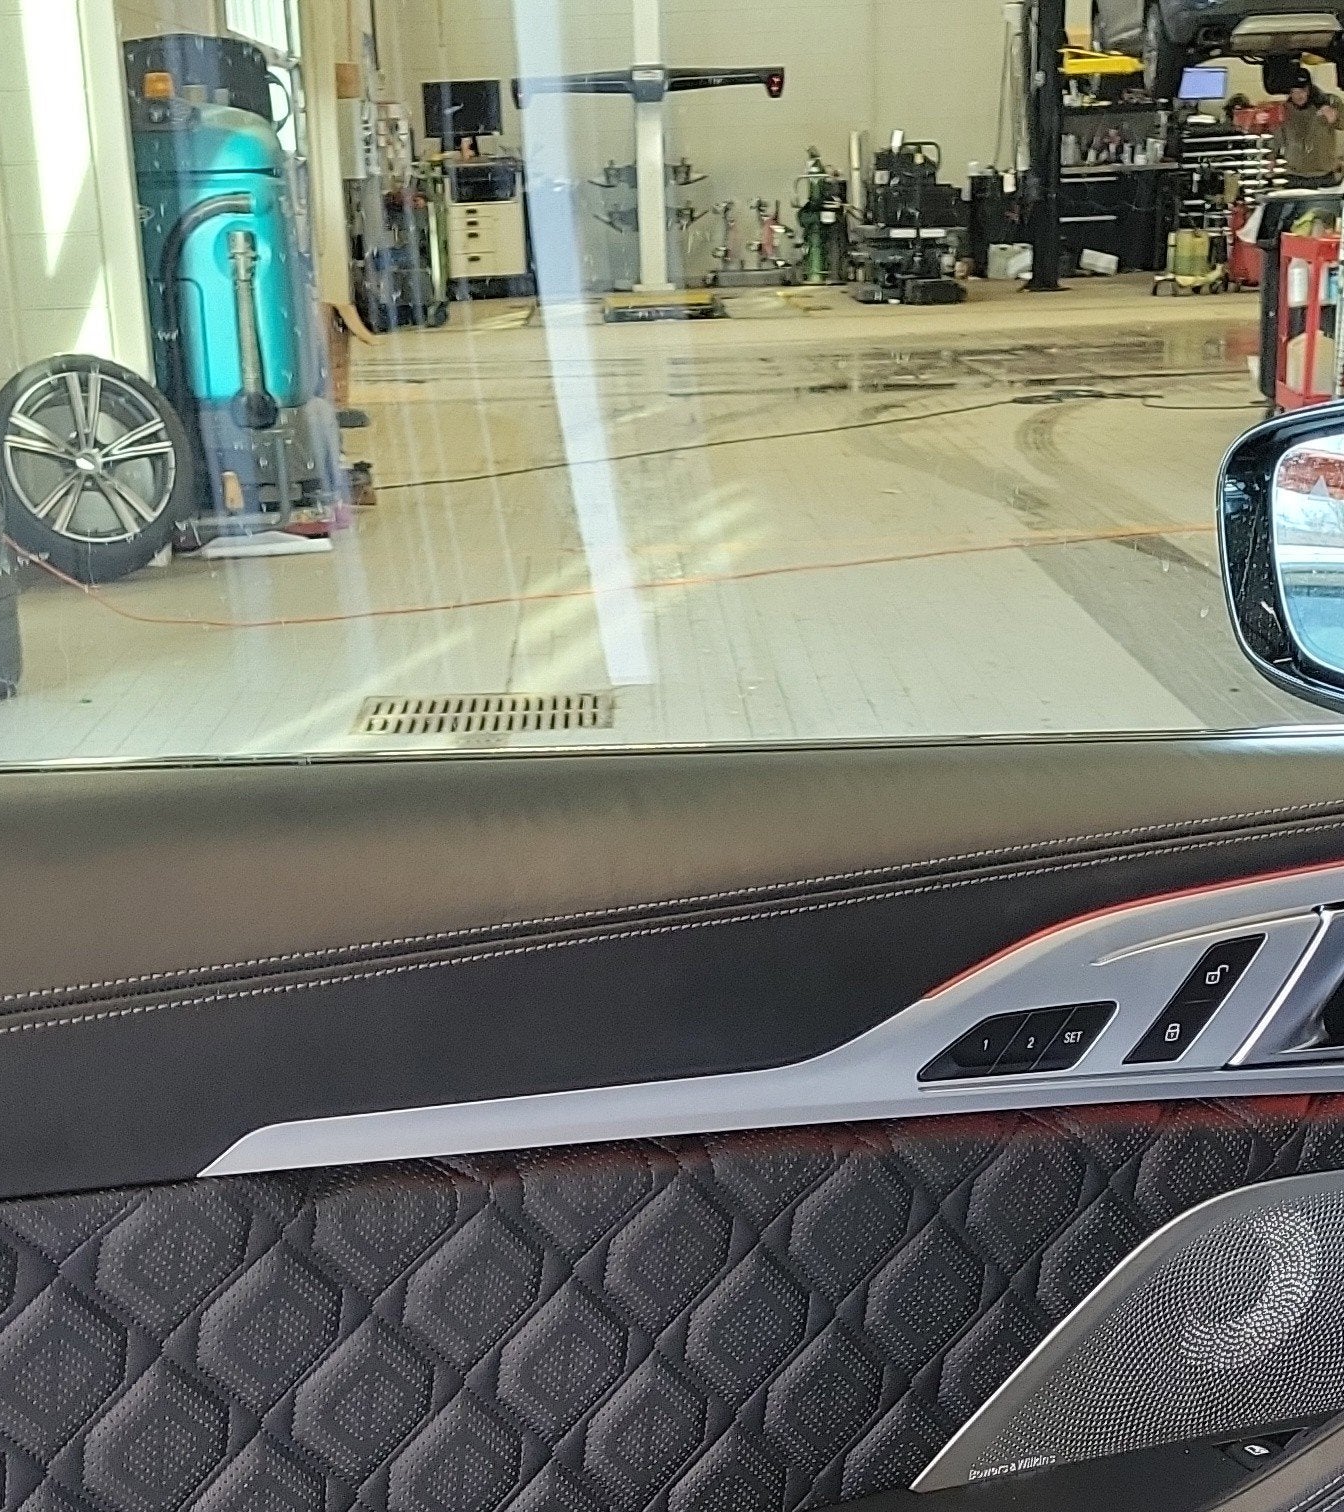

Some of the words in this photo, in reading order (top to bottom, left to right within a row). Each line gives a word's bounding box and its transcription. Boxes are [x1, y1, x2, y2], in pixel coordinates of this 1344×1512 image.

[983, 1039, 988, 1051] 1
[1026, 1036, 1035, 1048] 2
[1063, 1031, 1083, 1044] SET
